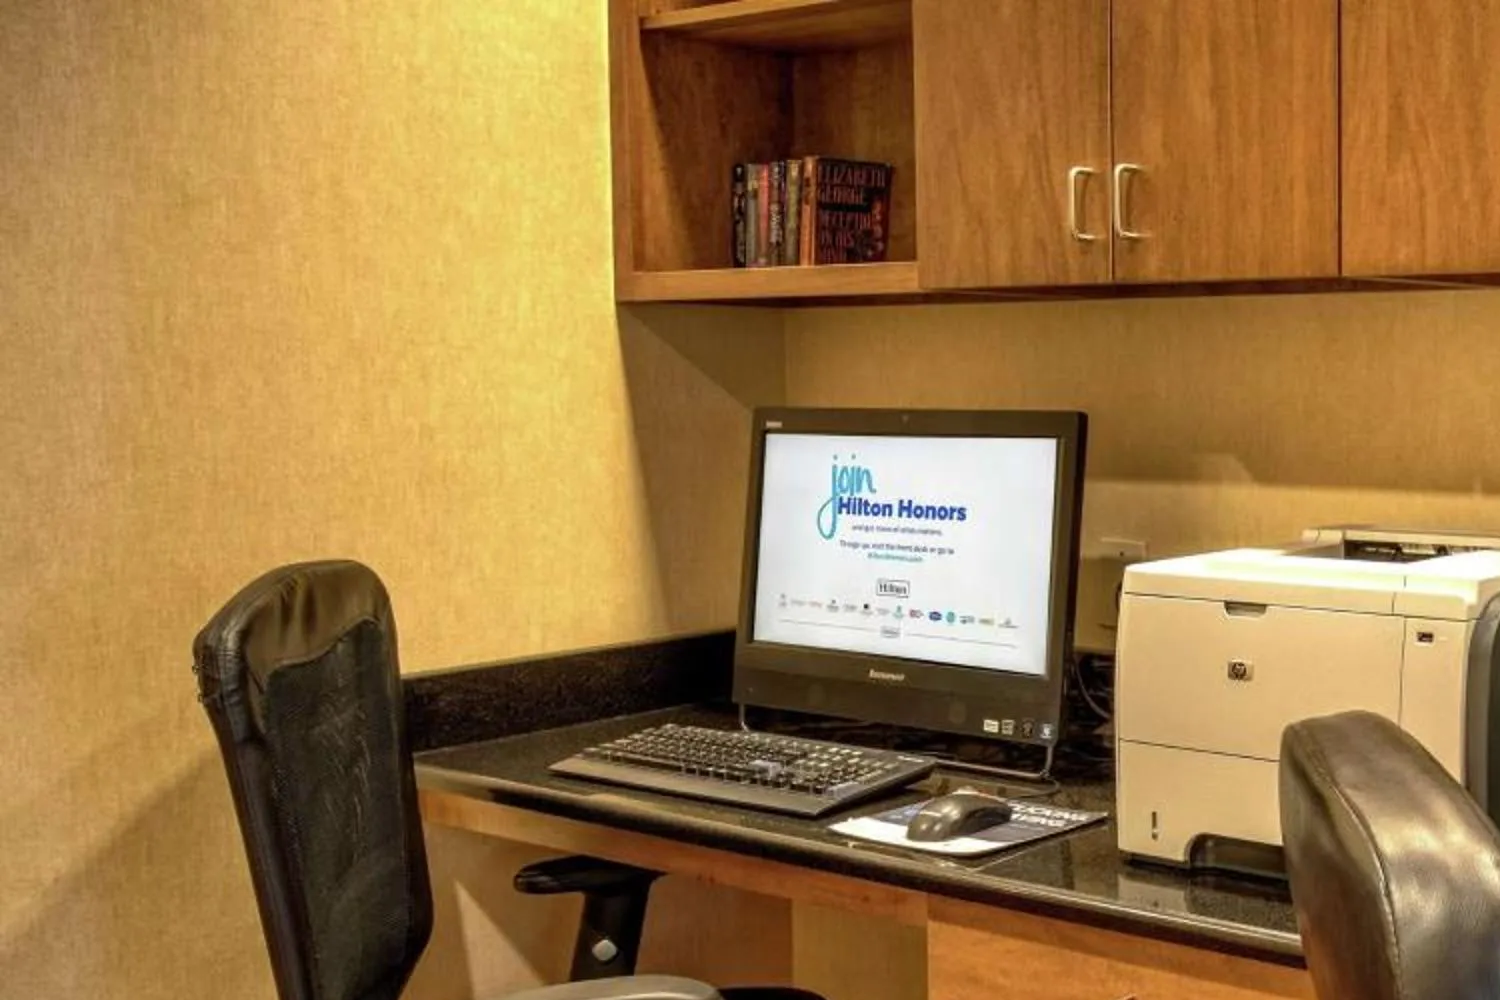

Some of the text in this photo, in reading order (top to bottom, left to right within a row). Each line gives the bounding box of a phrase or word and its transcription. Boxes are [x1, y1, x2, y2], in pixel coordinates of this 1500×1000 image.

[817, 454, 877, 540] join
[837, 496, 968, 522] Hilton Honors
